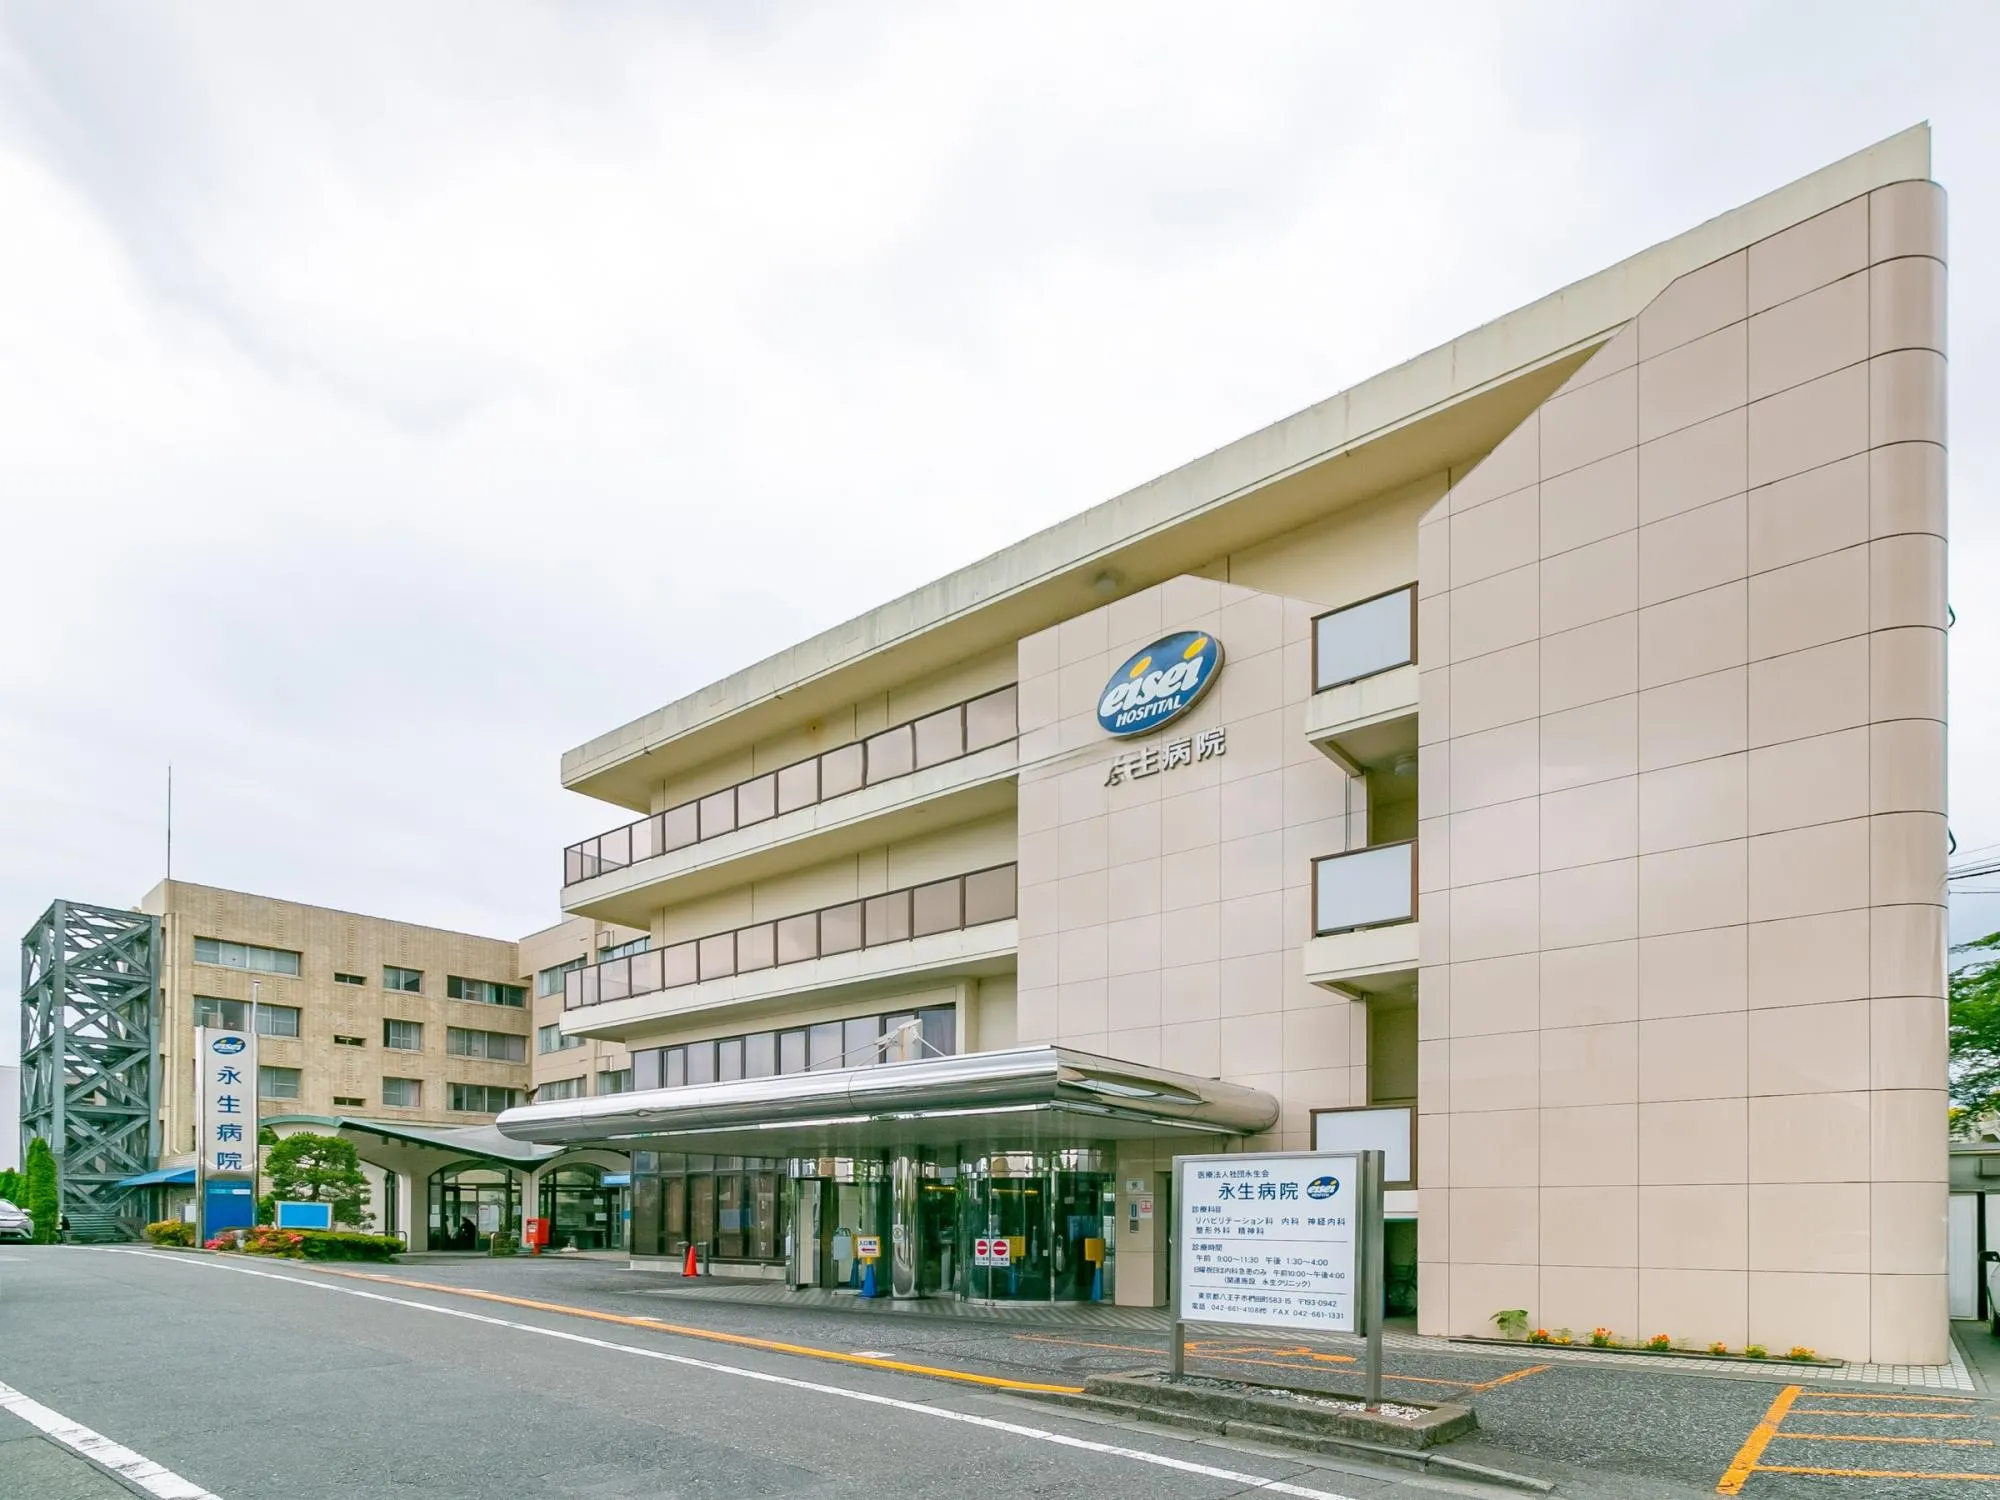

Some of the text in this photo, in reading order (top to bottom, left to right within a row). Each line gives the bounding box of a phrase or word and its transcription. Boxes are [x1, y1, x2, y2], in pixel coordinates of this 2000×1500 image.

[1100, 637, 1208, 717] eisei
[1115, 695, 1182, 728] HOSPITAL
[216, 1065, 242, 1170] 永生病院
[1197, 1169, 1270, 1179] 医療法人社団永生会
[1218, 1182, 1299, 1200] 永生病院
[1191, 1205, 1222, 1213] 診療科目
[1195, 1216, 1346, 1226] リハビリテーション科 内科 神経内科
[1196, 1226, 1264, 1235] 整形外科 精神科
[1191, 1243, 1223, 1251] 診療時間
[1196, 1254, 1211, 1262] 午前
[1265, 1256, 1281, 1265] 午後
[1191, 1302, 1206, 1310] 電話
